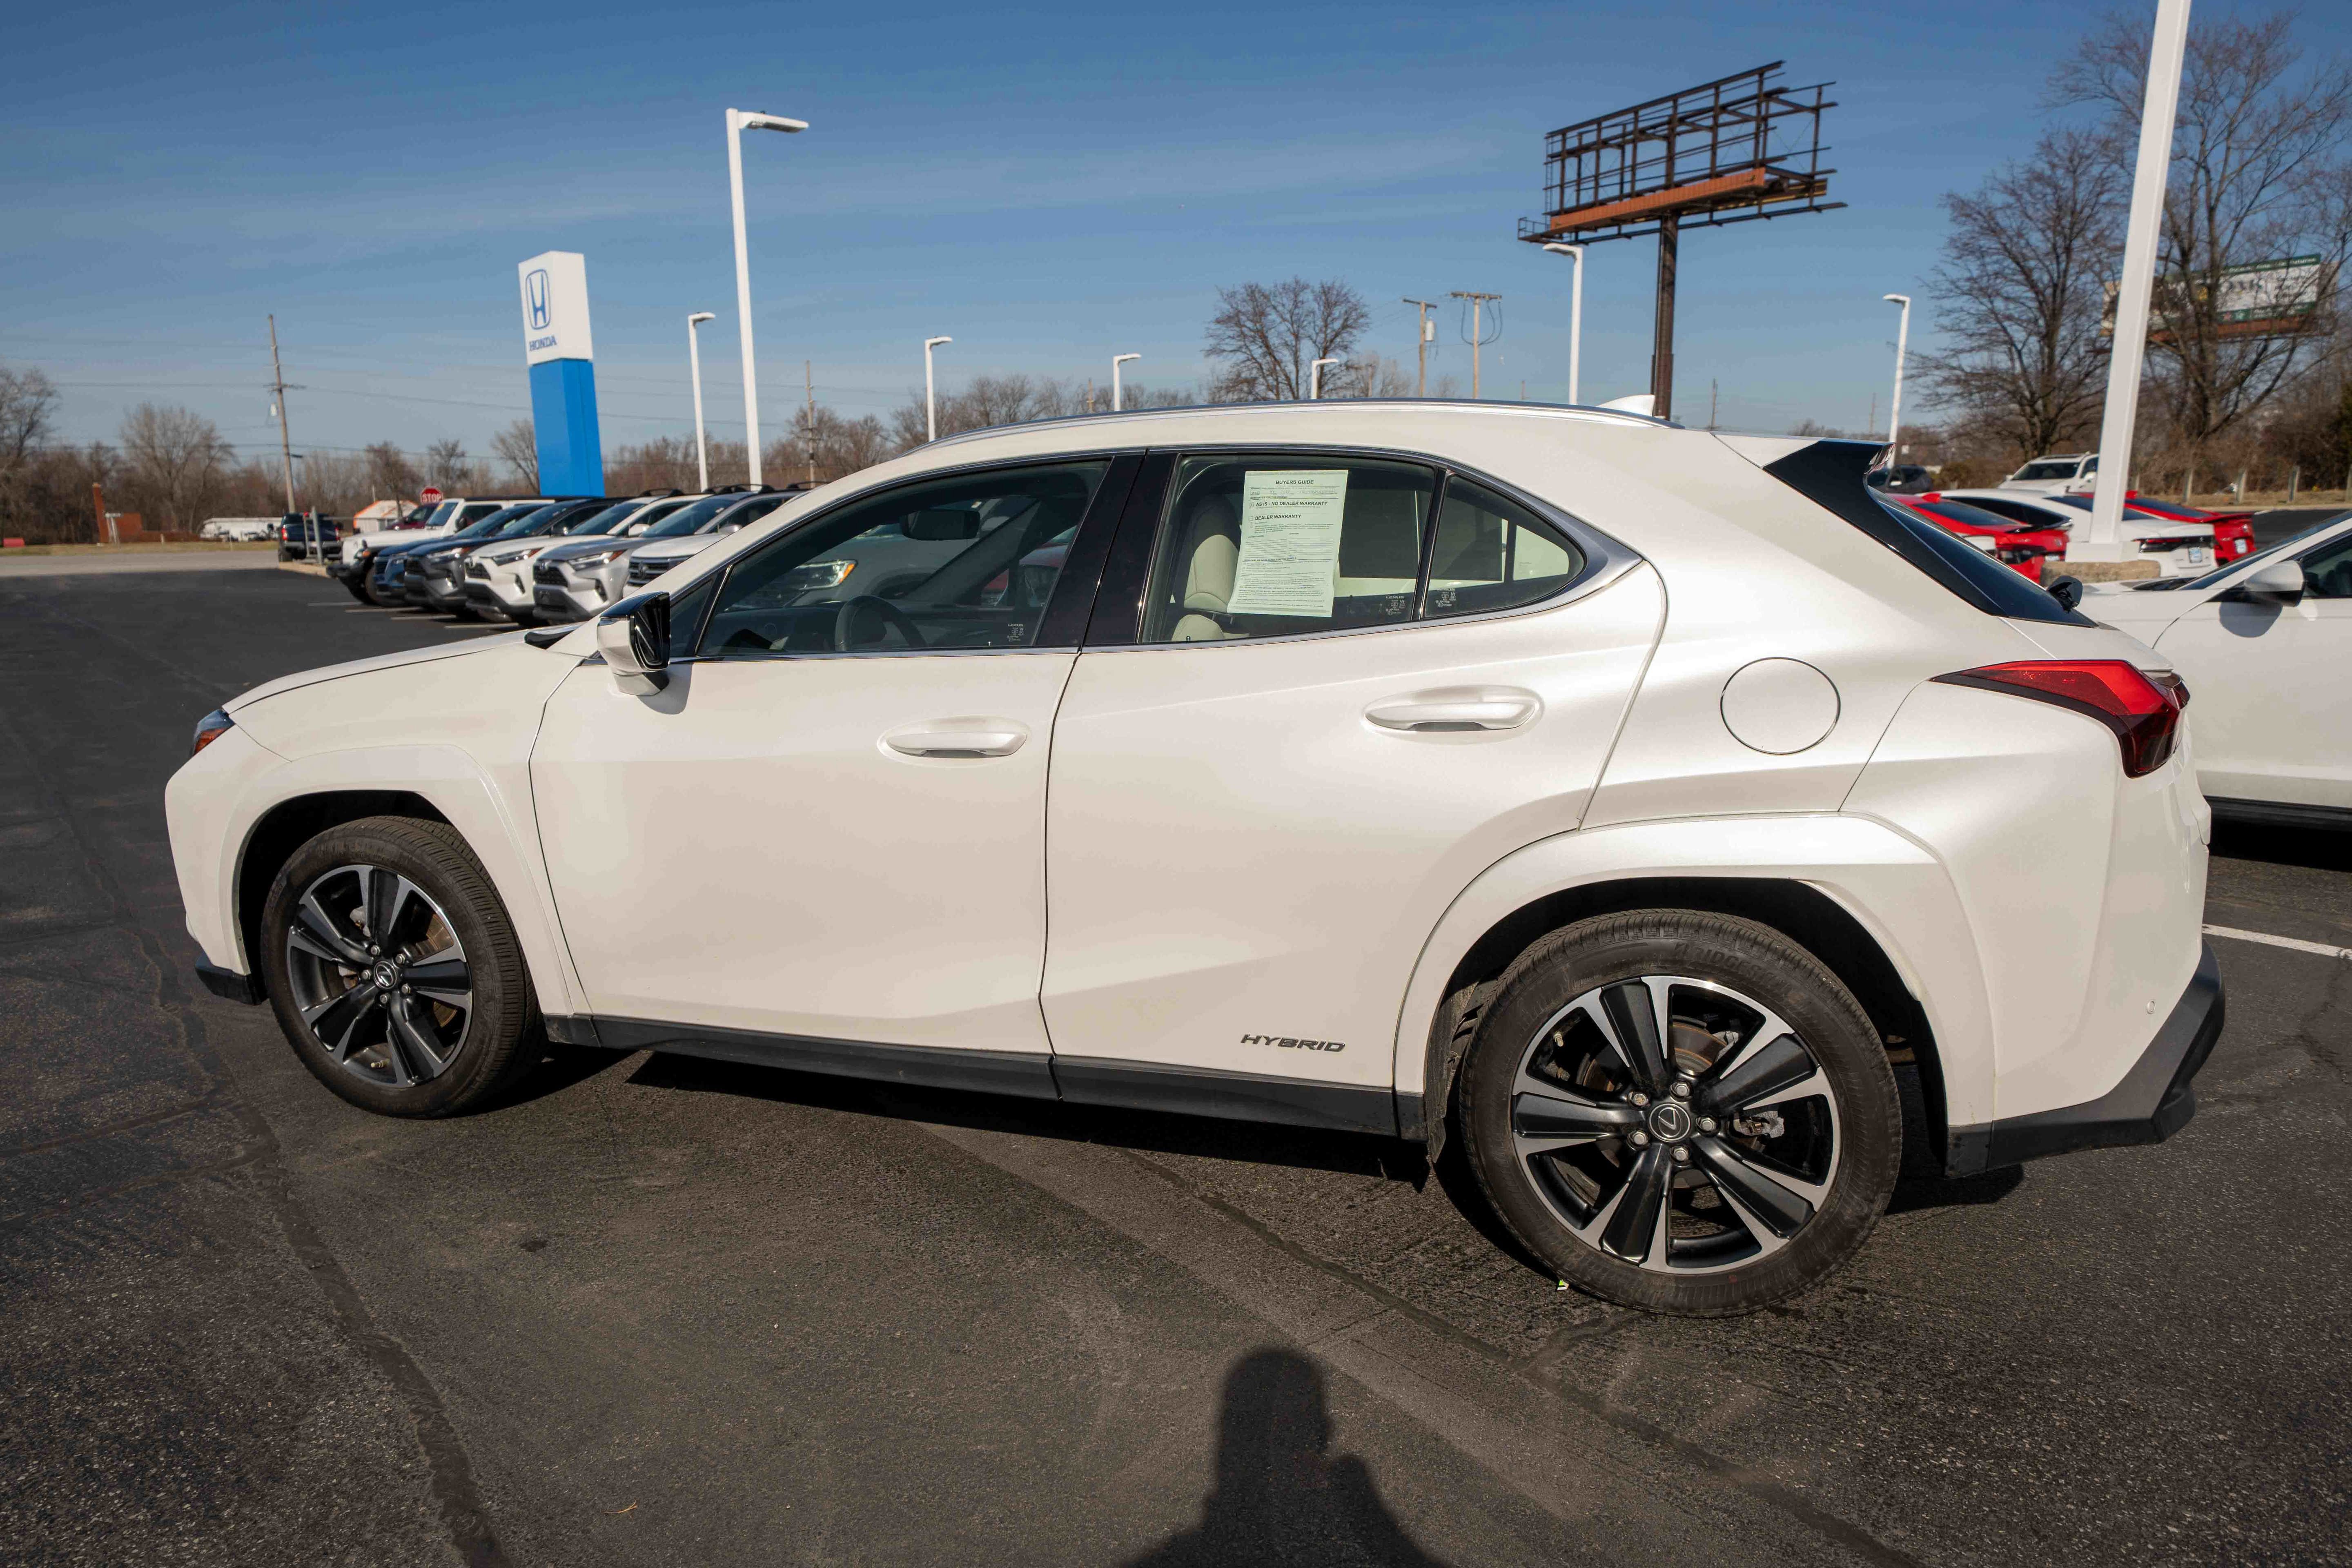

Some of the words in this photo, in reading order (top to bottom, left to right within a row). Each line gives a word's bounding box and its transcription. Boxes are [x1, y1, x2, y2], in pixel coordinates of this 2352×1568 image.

[529, 335, 557, 352] HONDA
[422, 493, 441, 503] STOP
[1240, 1033, 1345, 1052] HYBRID
